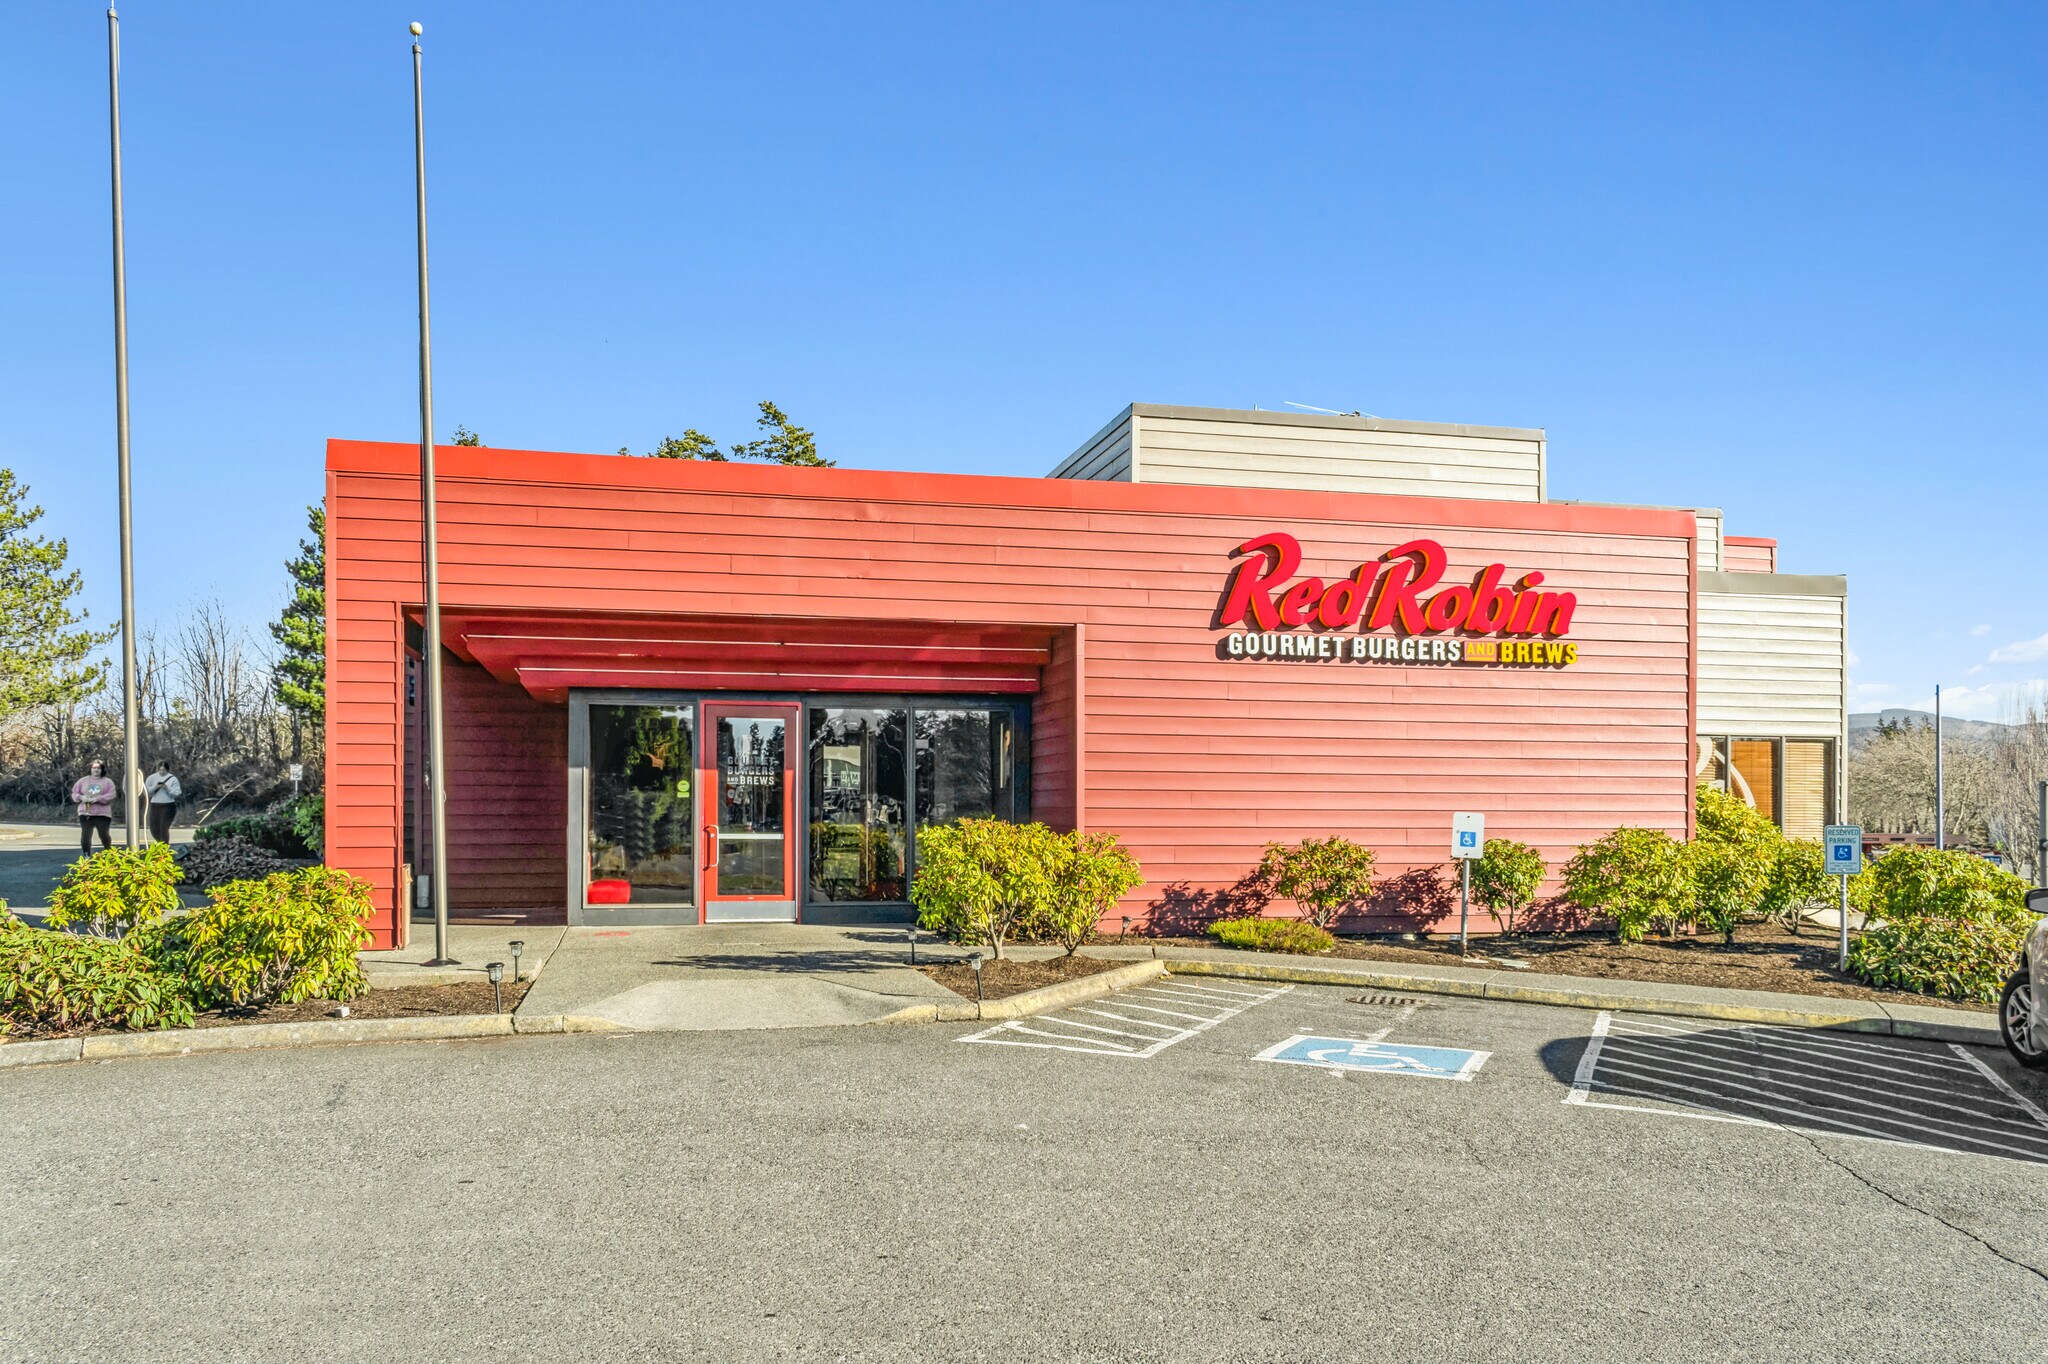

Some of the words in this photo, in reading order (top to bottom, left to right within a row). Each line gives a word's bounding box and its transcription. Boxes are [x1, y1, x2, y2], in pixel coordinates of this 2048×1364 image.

[1220, 532, 1381, 631] Red
[1368, 539, 1577, 635] Robin
[1229, 632, 1345, 658] GOURMET
[1353, 637, 1461, 662] BURGERS
[1466, 642, 1495, 656] AND
[1501, 641, 1578, 665] BREWS
[727, 766, 775, 776] BURGERS
[740, 776, 775, 785] BREWS
